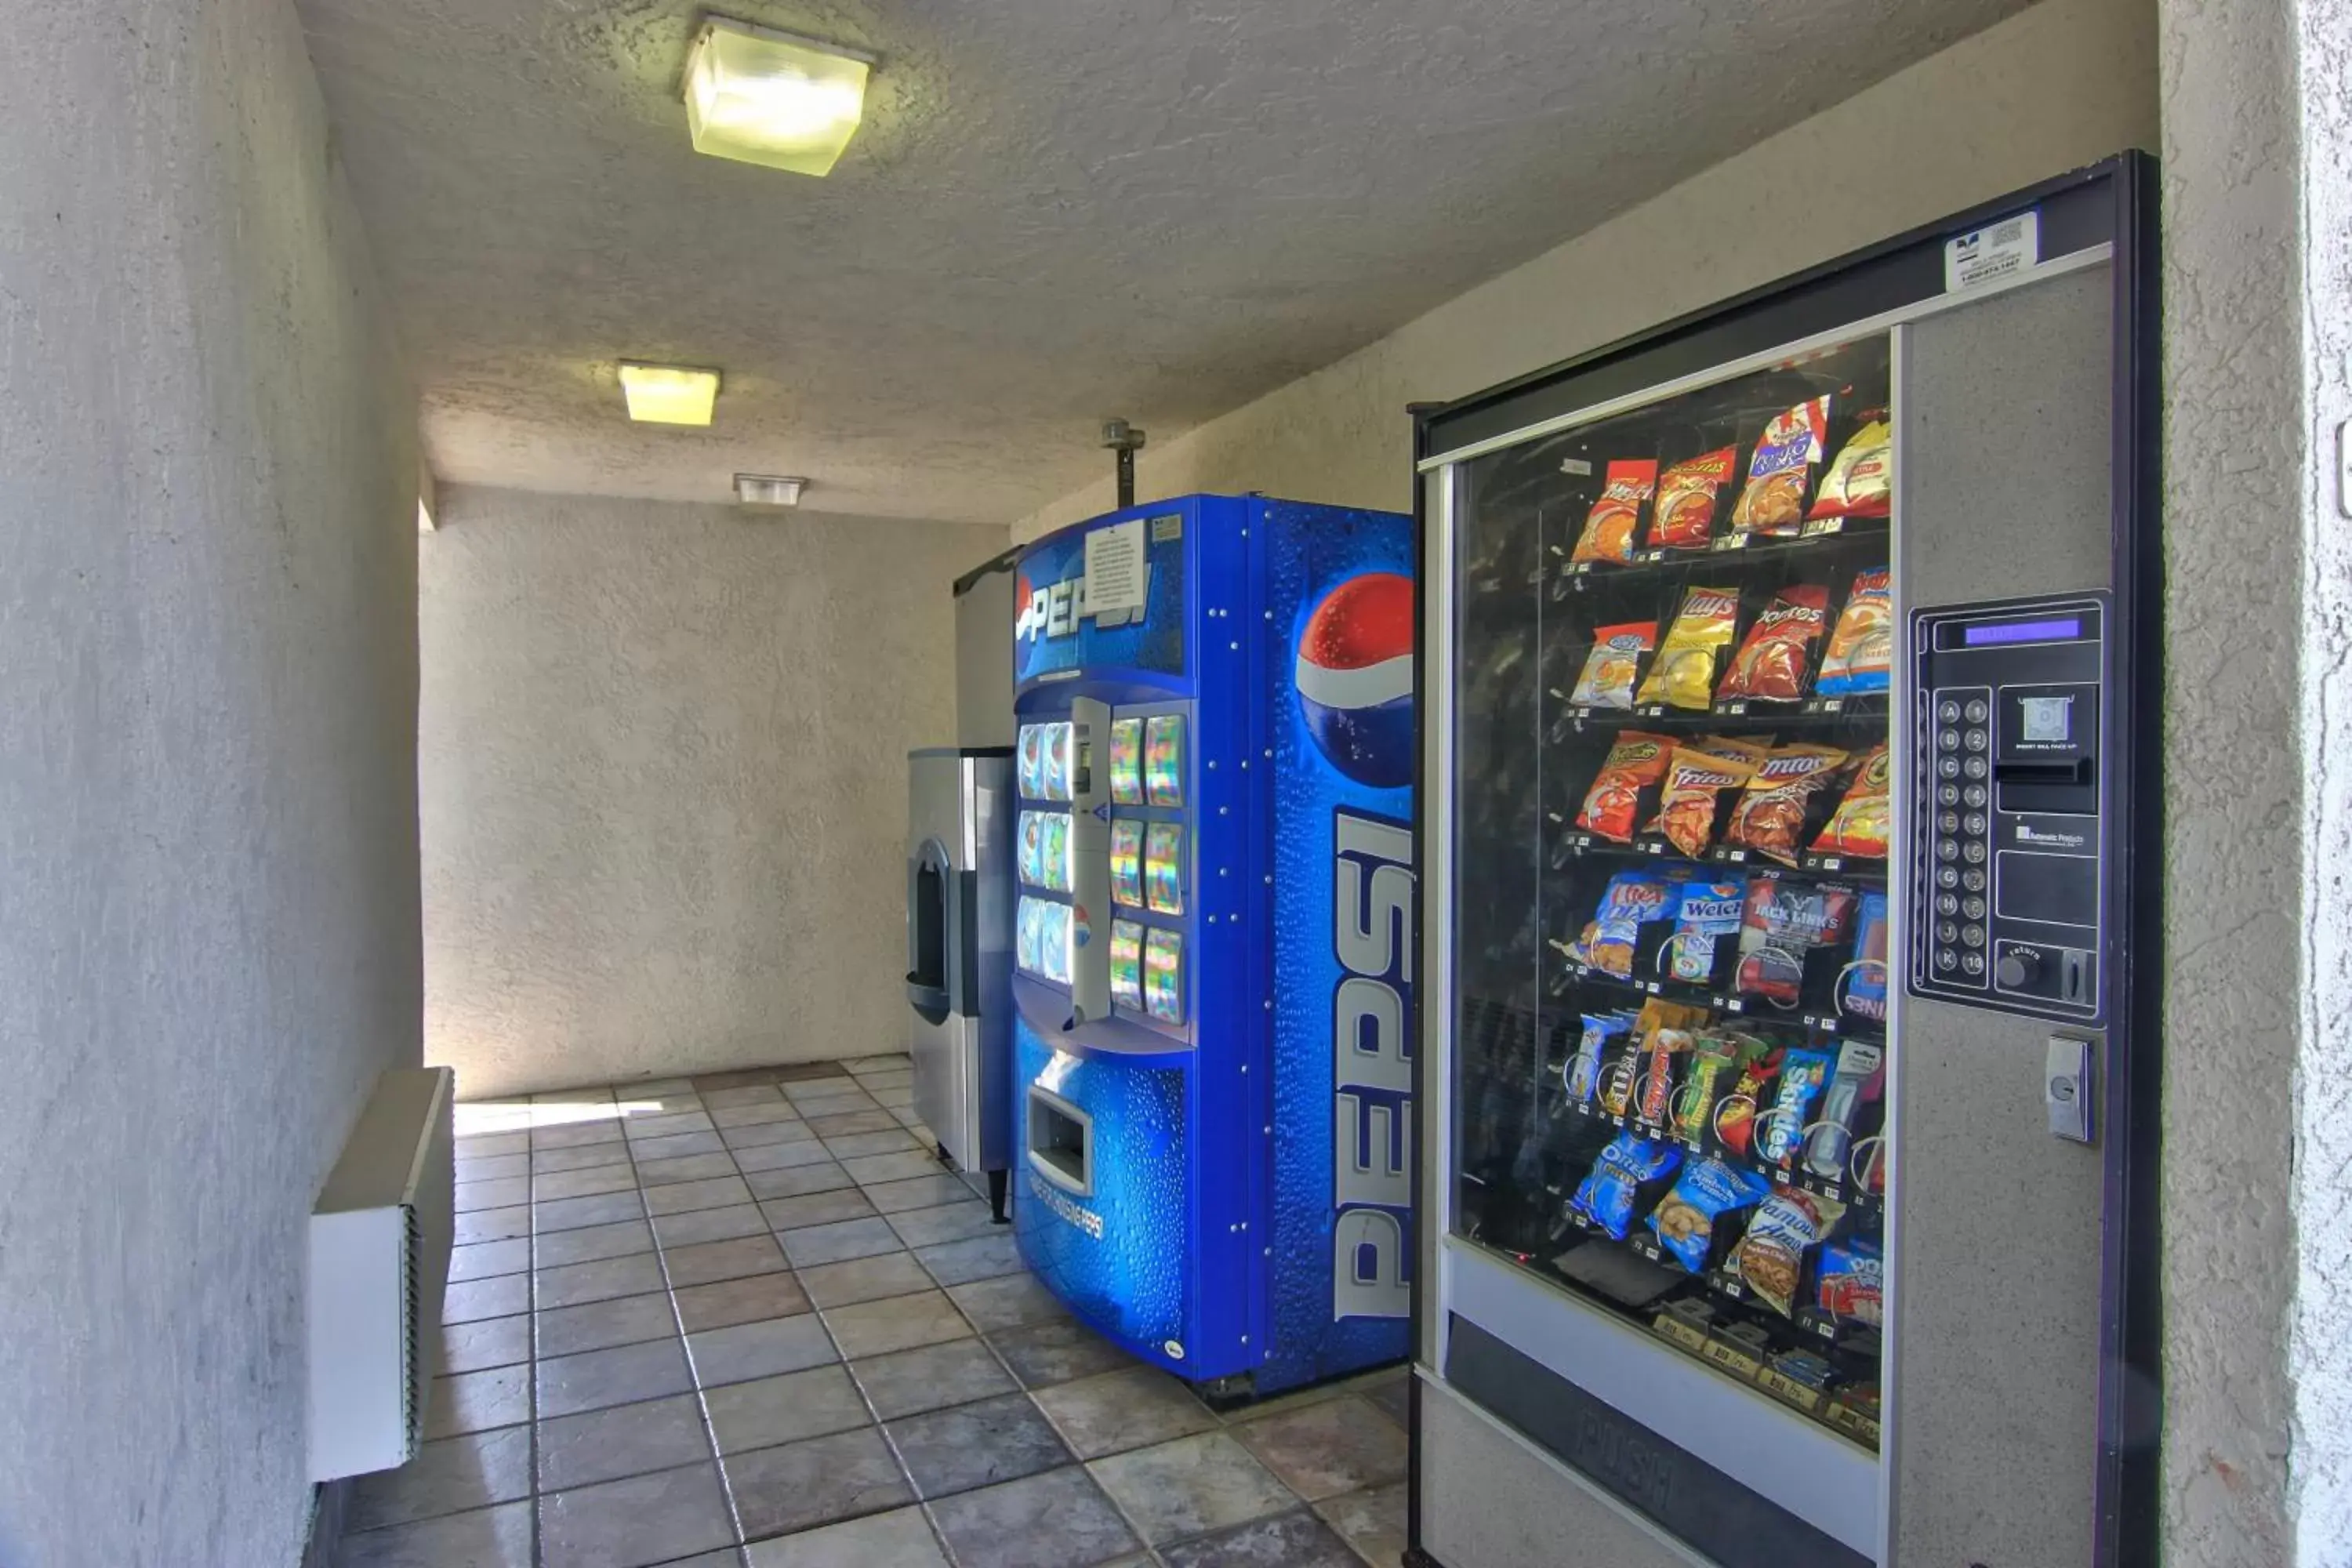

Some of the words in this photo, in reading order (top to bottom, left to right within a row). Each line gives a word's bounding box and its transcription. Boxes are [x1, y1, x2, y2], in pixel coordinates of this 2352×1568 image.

[2009, 946, 2041, 960] return
[1334, 812, 1412, 1323] PEPSI
[1601, 1144, 1647, 1181] OREO
